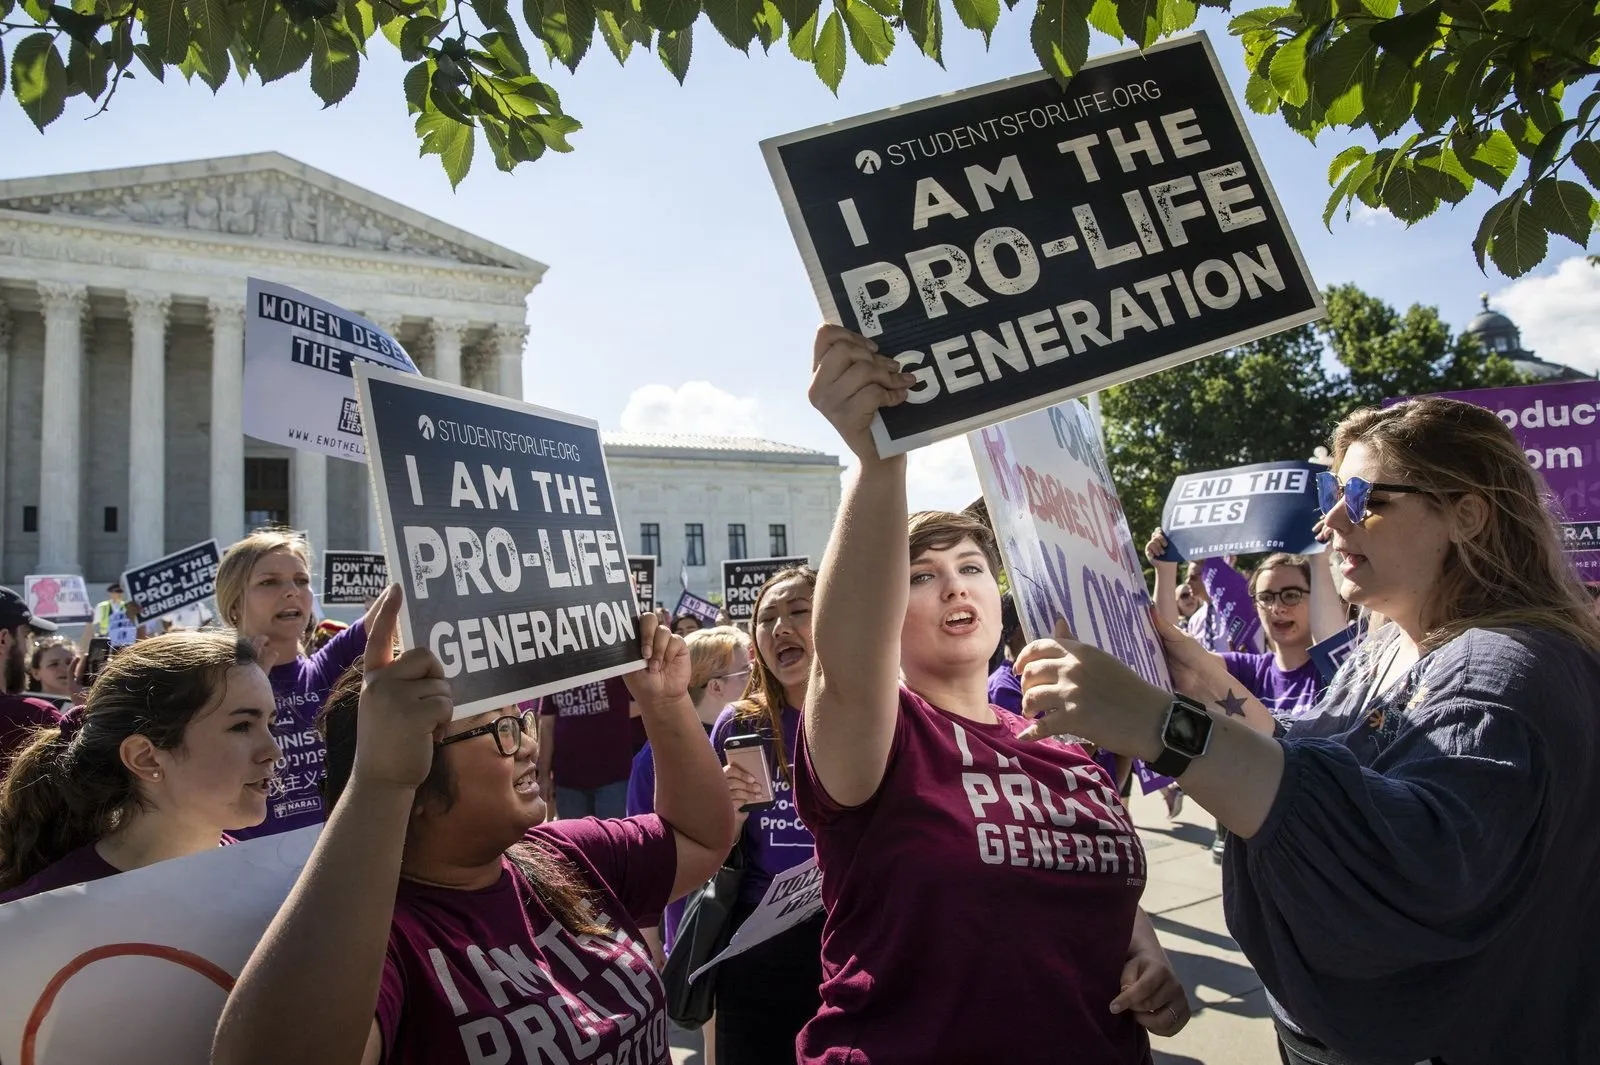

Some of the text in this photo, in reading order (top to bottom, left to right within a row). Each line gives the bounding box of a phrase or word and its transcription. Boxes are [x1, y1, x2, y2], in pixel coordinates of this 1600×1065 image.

[887, 79, 1162, 166] STUDENTSFORLIFE.ORG
[838, 107, 1212, 248] I AM THE
[840, 161, 1268, 339] PRO-LIFE
[261, 294, 341, 338] WOMEN
[351, 323, 411, 367] DESE
[893, 243, 1287, 405] GENERATION
[296, 338, 342, 373] THE
[340, 420, 362, 433] LIES
[342, 411, 360, 423] THE
[439, 419, 581, 462] STUDENTSFORLIFE.ORG
[404, 454, 602, 516] I AM THE
[1181, 471, 1303, 500] END THE
[1172, 502, 1244, 527] LIES
[134, 581, 141, 592] I
[148, 568, 175, 587] AM
[179, 553, 213, 573] THE
[332, 562, 371, 573] DON'T
[332, 573, 388, 587] PLANN
[402, 525, 627, 600] PRO-LIFE
[730, 574, 735, 585] I
[741, 573, 766, 585] AM
[133, 563, 218, 603] PRO-LIFE
[428, 599, 637, 679] GENERATION
[287, 799, 318, 810] NARAL
[760, 816, 808, 831] Pro-C
[428, 947, 470, 1017] I
